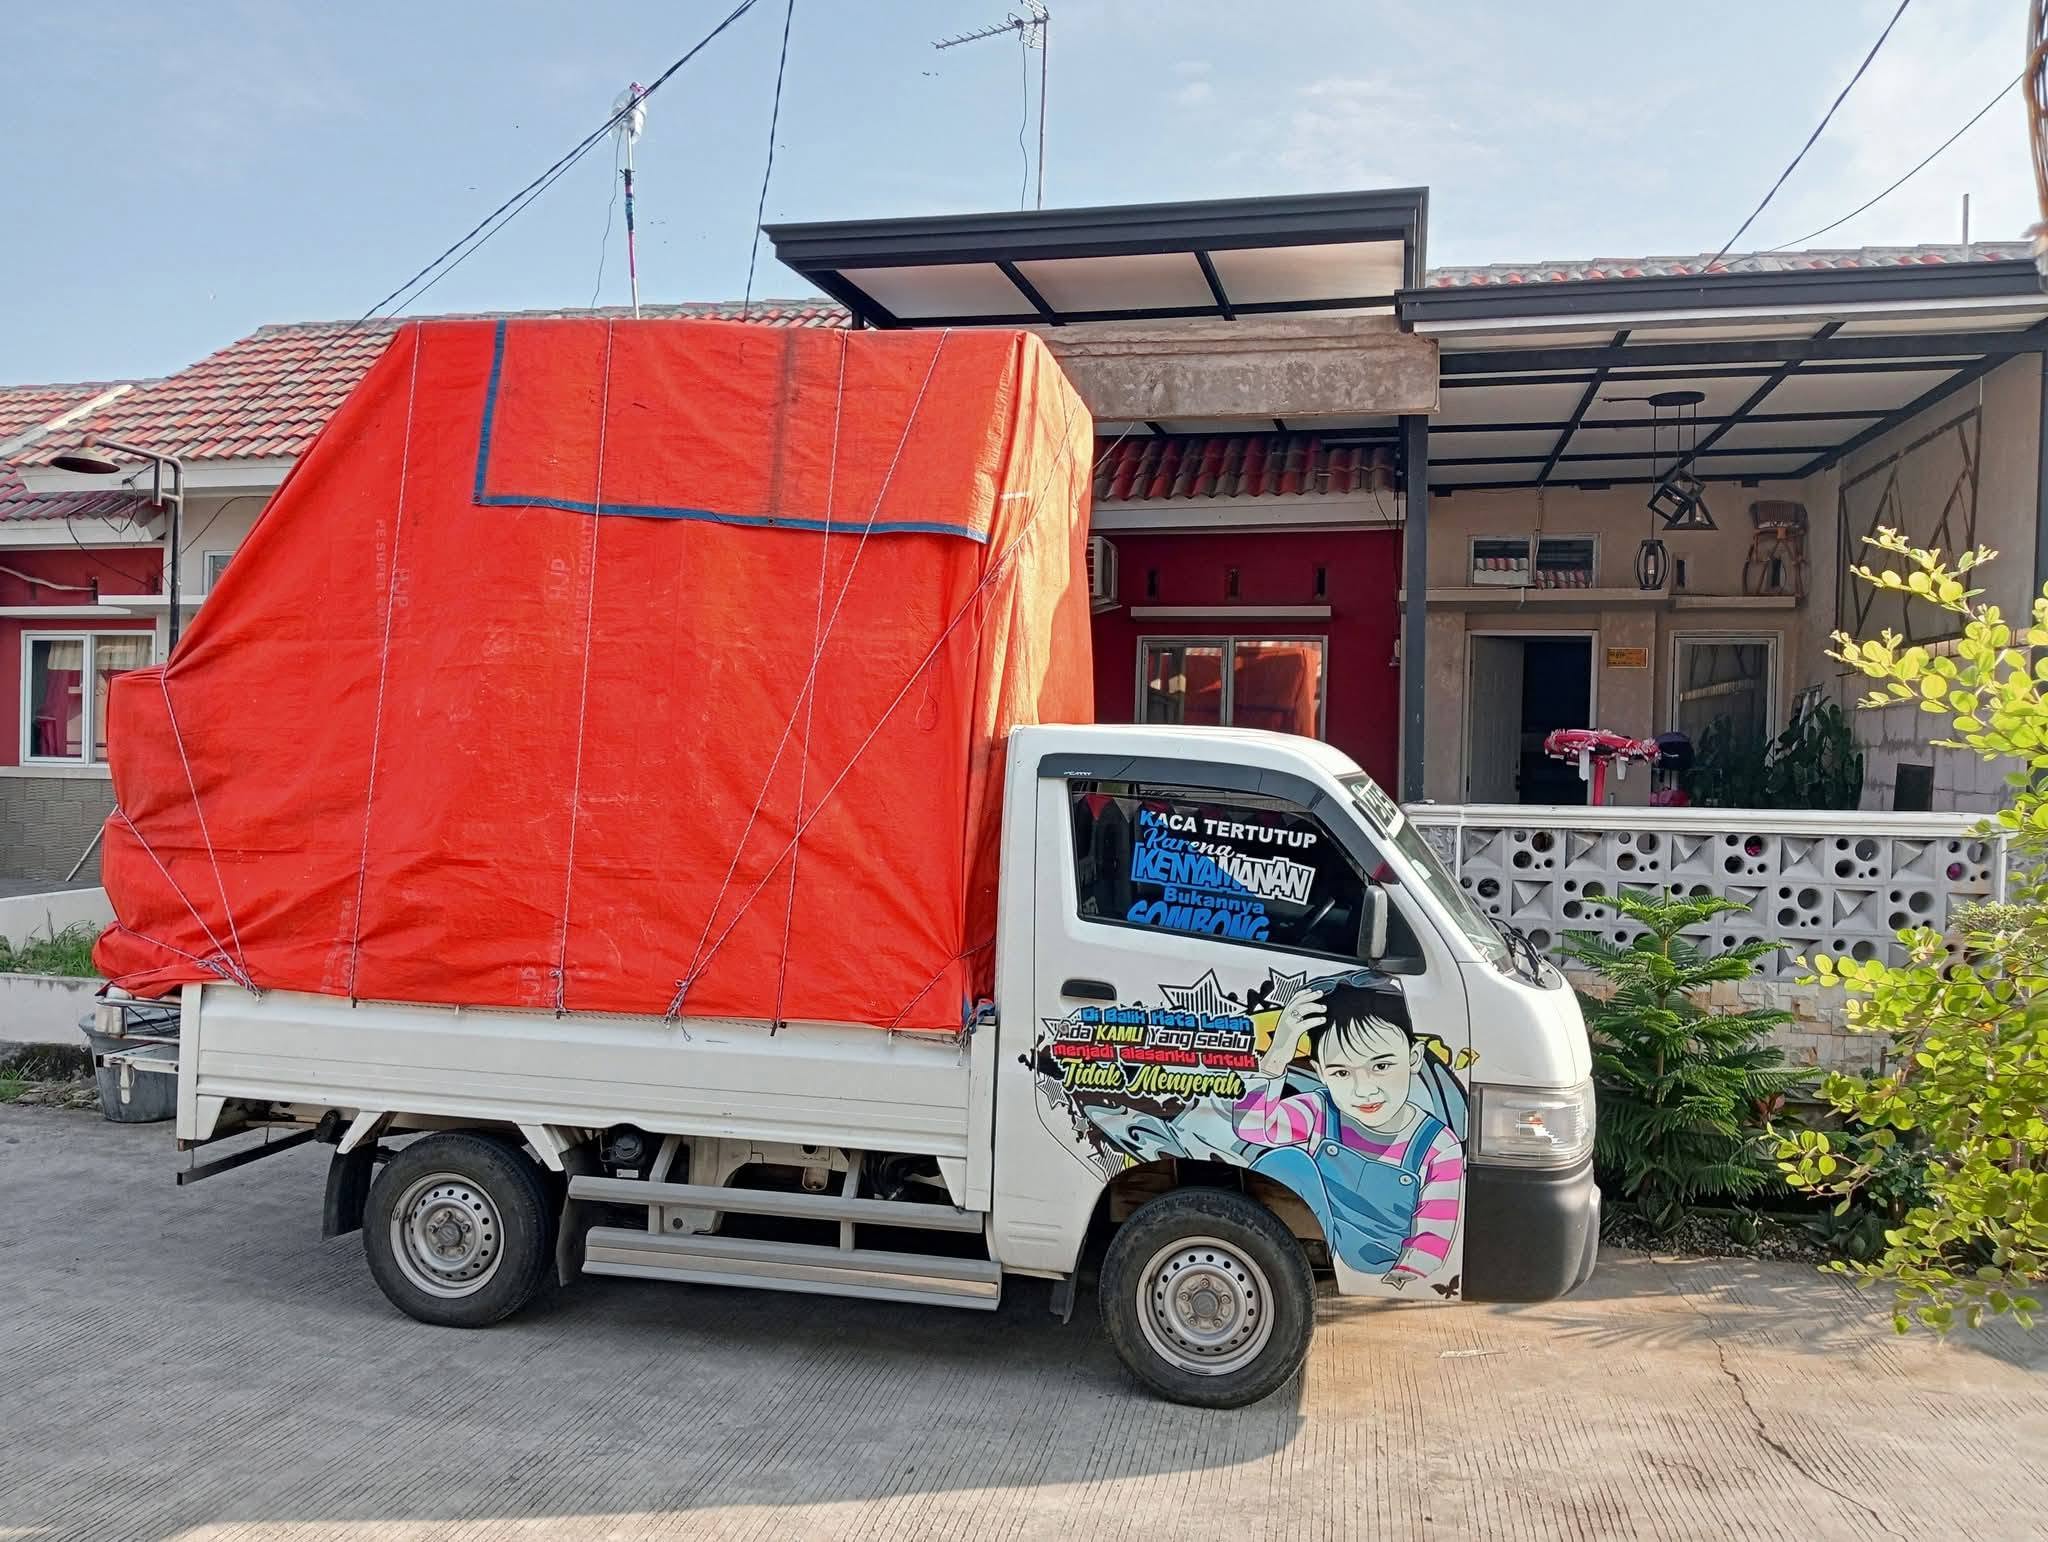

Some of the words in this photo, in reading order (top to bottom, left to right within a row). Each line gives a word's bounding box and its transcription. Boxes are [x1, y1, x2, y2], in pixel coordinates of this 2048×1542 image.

[1140, 810, 1197, 833] KACA
[1203, 819, 1317, 849] TERTUTUP
[1143, 827, 1235, 858] Karena
[1135, 847, 1311, 900] KENYAMANAN
[1164, 886, 1265, 915] Bukannya
[1127, 900, 1271, 942] SOMBONG
[1081, 1008, 1100, 1021] Di
[1054, 1044, 1114, 1060] menjadi
[1096, 1025, 1144, 1042] KAMU
[1150, 1026, 1192, 1049] Yang
[1196, 1032, 1248, 1049] selalu
[1061, 1057, 1122, 1087] Tidak
[1127, 1065, 1243, 1098] Menyerah
